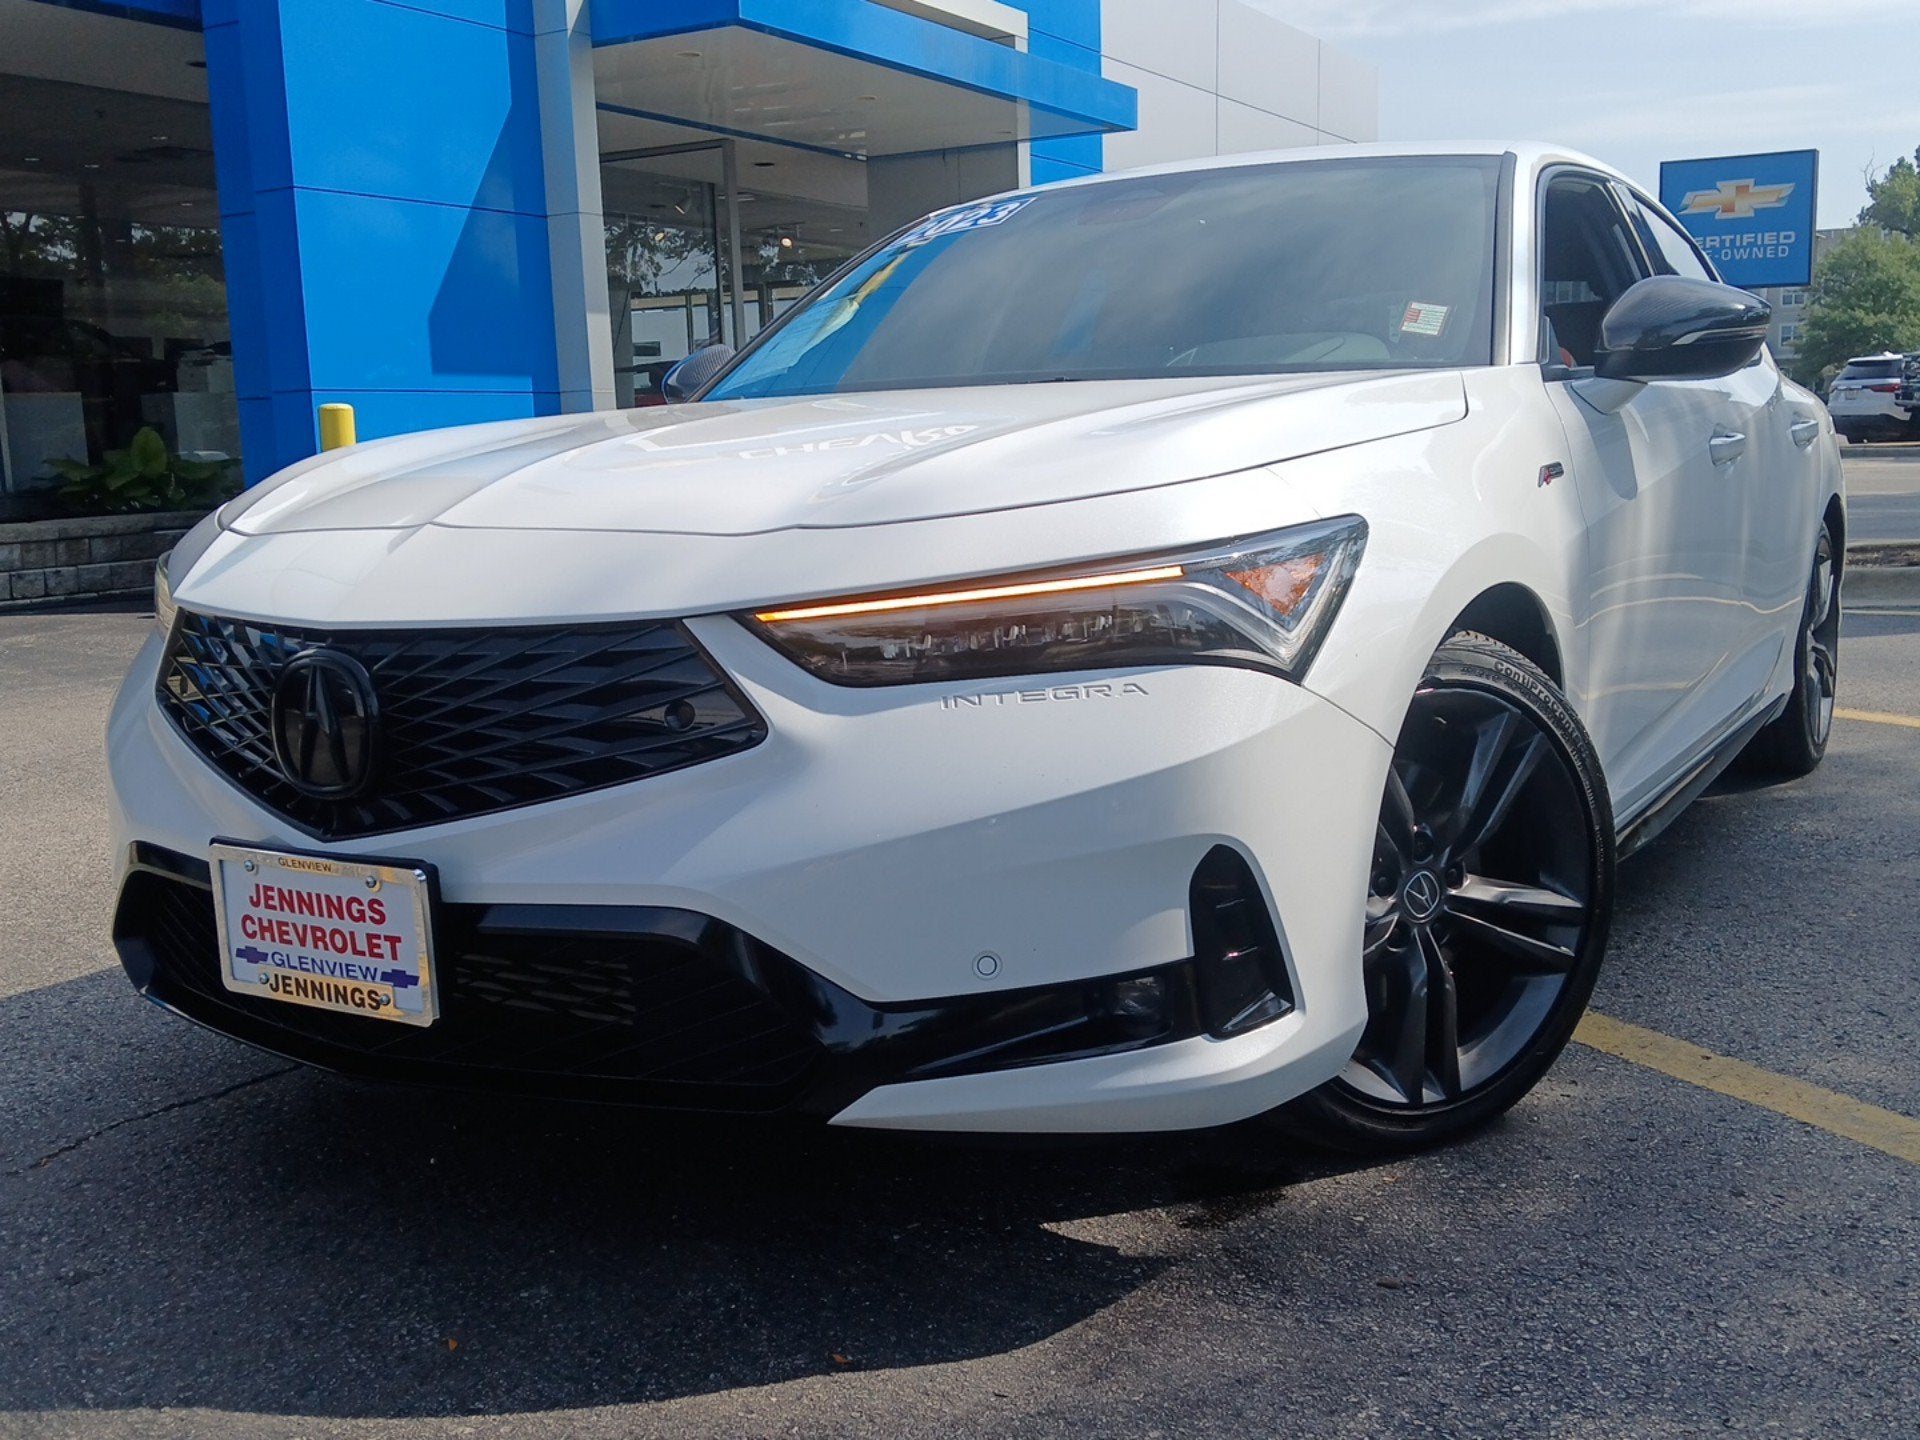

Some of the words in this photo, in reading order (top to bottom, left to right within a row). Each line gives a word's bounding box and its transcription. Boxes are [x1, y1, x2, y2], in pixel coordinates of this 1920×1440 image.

[1694, 231, 1796, 250] ERTIFIED
[1706, 245, 1789, 261] -OWNED
[940, 683, 1149, 709] INTEGRA
[277, 857, 332, 872] GLENVIEW
[249, 883, 386, 925] JENNINGS
[241, 914, 402, 961] CHEVROLET
[271, 951, 378, 982] GLENVIEW
[269, 974, 382, 1011] JENNINGS
